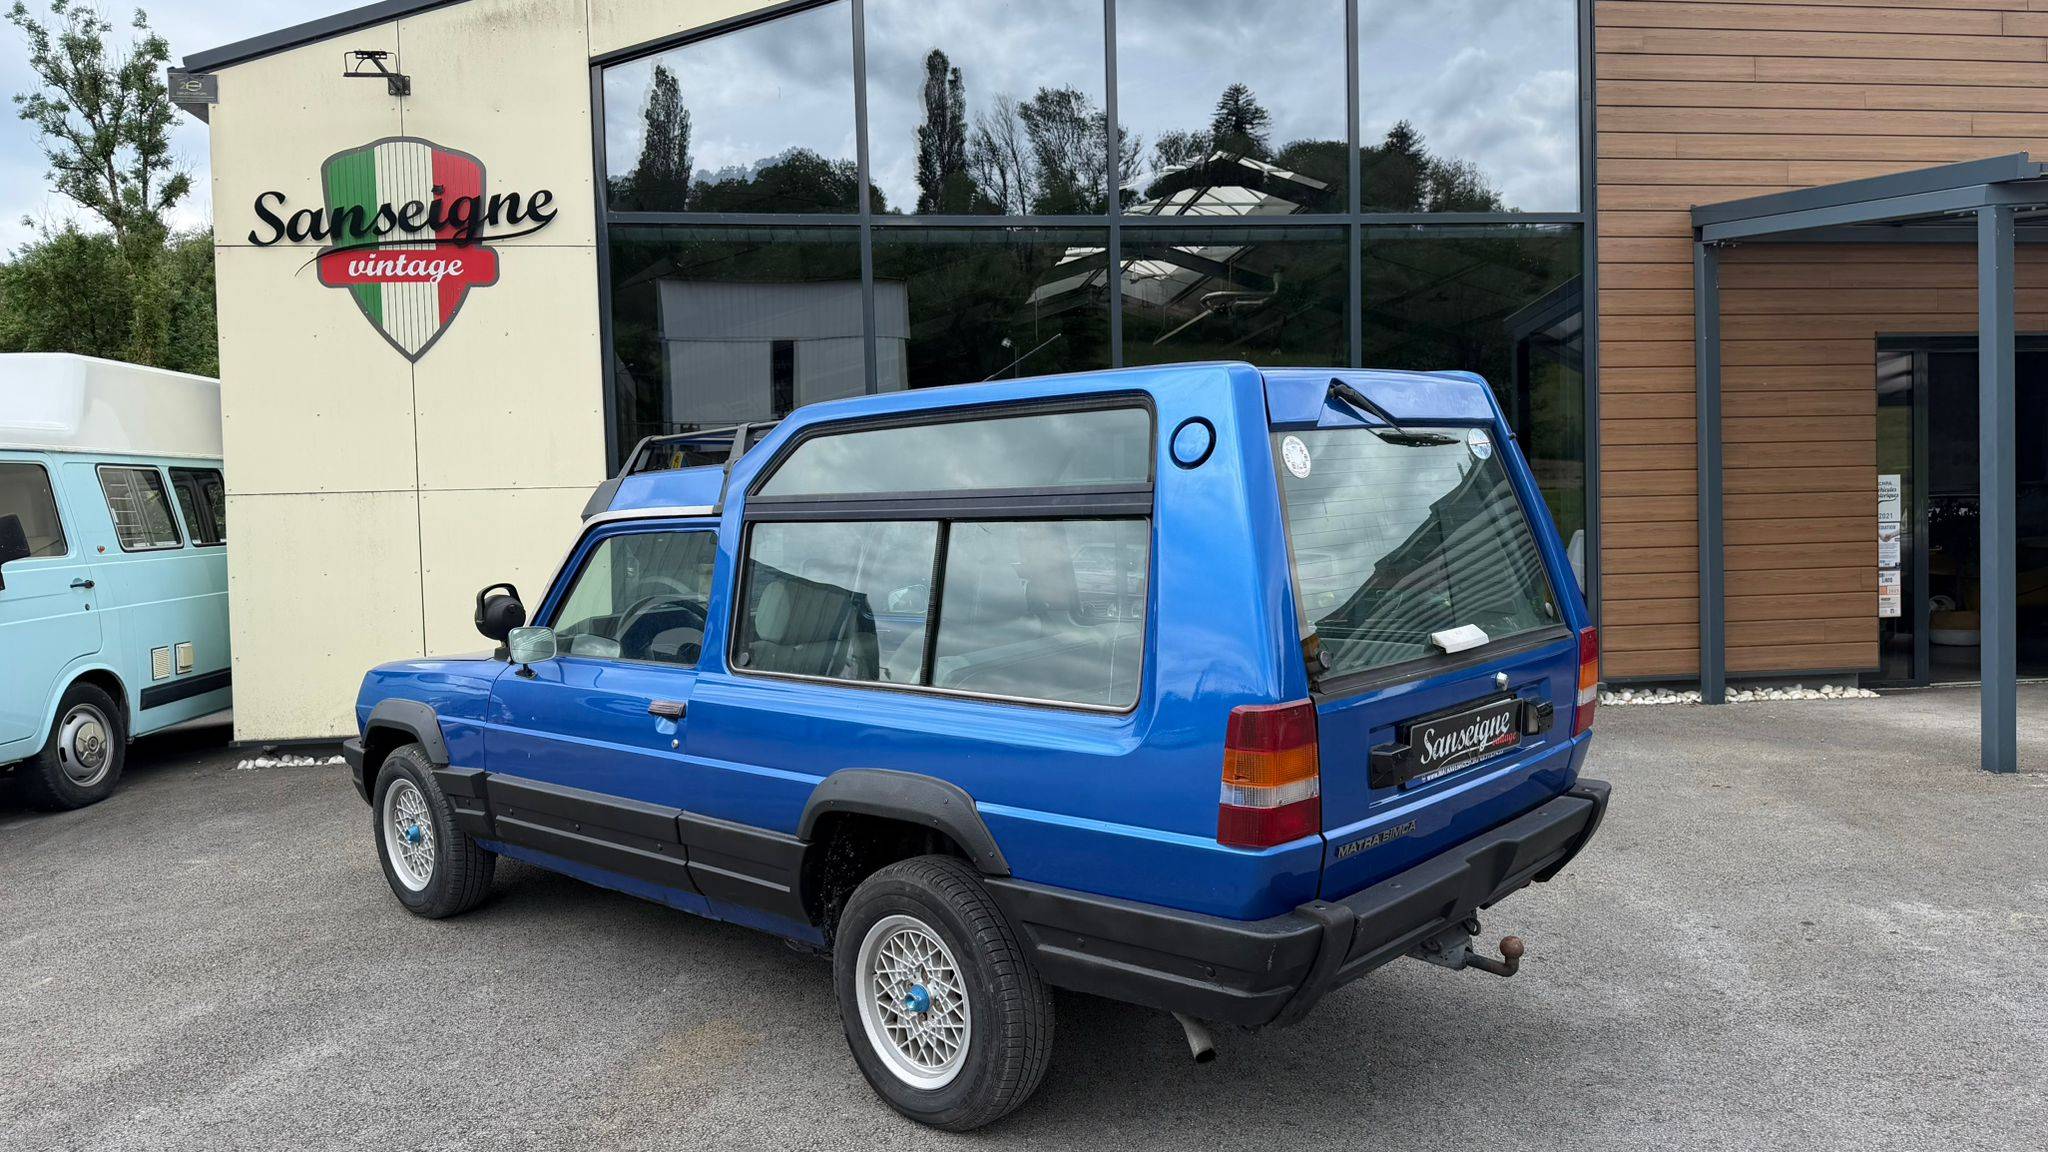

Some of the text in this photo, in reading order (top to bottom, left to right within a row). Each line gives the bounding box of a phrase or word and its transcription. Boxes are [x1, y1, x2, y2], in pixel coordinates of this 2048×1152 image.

[248, 185, 558, 247] Sanseigne
[348, 253, 464, 283] vintage
[1421, 712, 1509, 764] Sanseigne
[1338, 819, 1417, 858] MATRA SIMCA
